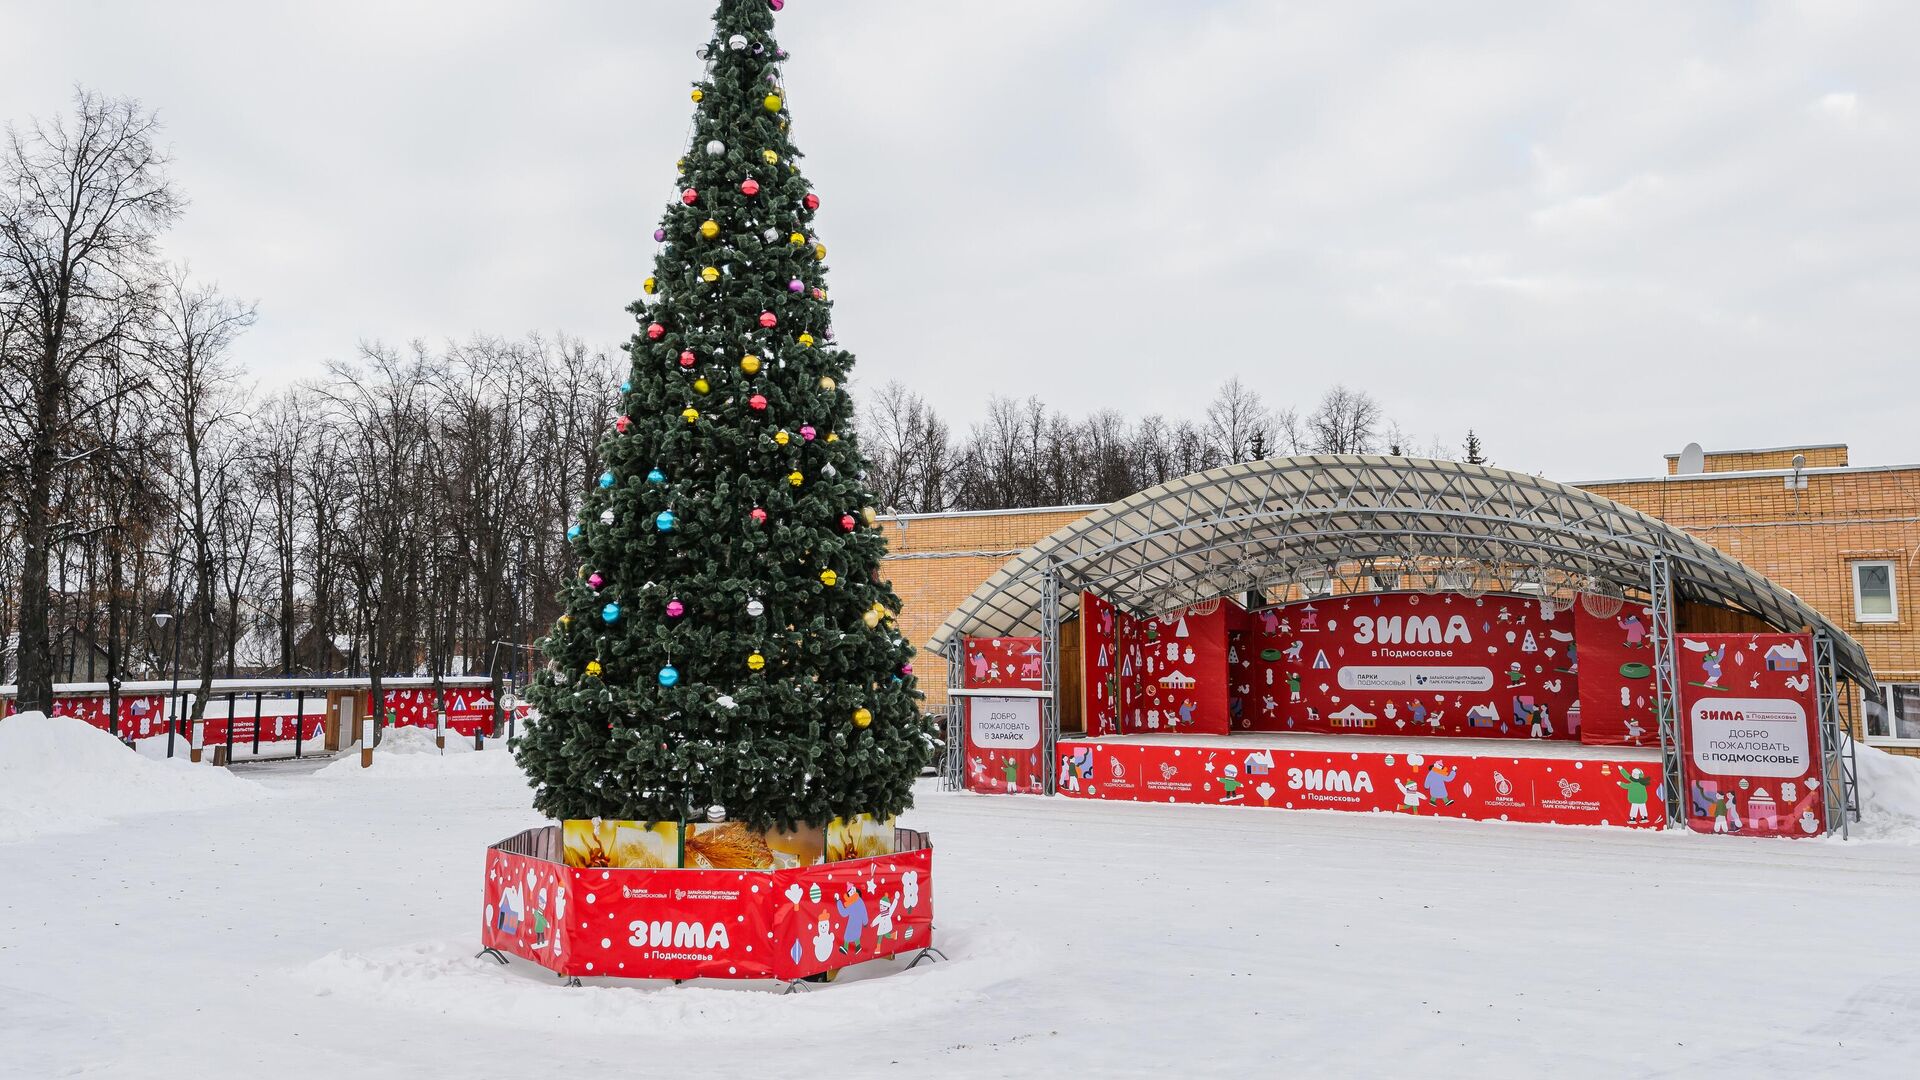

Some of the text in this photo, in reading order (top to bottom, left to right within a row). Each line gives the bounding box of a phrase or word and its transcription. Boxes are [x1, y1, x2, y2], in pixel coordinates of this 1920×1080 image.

[1353, 615, 1472, 644] ЗИМА
[1381, 649, 1454, 658] Подмосковье
[991, 712, 1017, 720] ДОБРО
[1699, 710, 1745, 721] ЗИМА
[978, 722, 1030, 731] ПОЖАЛОВАТЬ
[985, 732, 1024, 741] В ЗАРАЙСК
[1728, 729, 1769, 739] ДОБРО
[1709, 741, 1790, 752] ПОЖАЛОВАТЬ
[1702, 752, 1799, 764] В ПОДМОСКОВЬЕ
[1287, 768, 1374, 793] ЗИМА
[1308, 793, 1361, 802] Подмосковье
[629, 920, 730, 950] ЗИМА
[652, 951, 713, 961] Подмосковье
